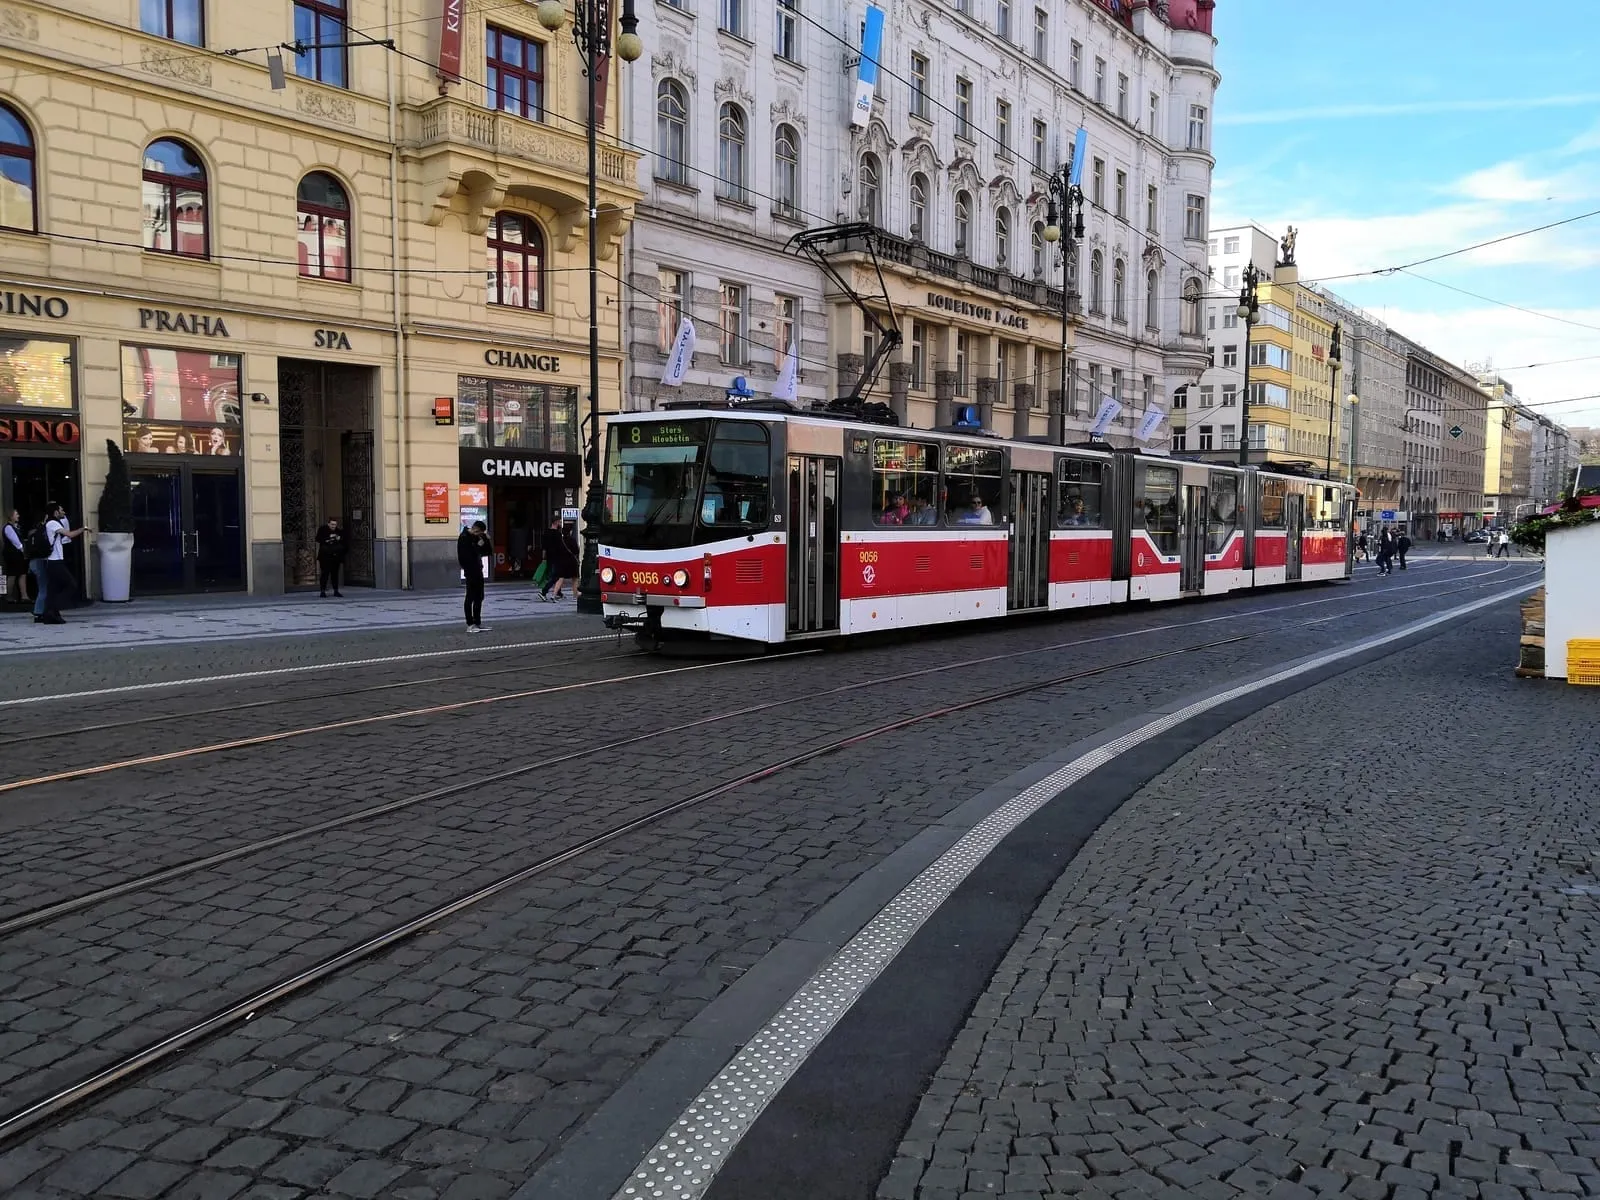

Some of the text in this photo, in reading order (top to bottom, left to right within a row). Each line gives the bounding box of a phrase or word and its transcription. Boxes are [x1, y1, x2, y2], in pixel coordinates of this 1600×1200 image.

[0, 291, 69, 318] INO
[928, 292, 992, 320] KONEKTOR
[139, 308, 229, 337] PRAHA
[314, 329, 352, 350] SPA
[484, 349, 560, 373] CHANGE
[632, 427, 640, 443] 8
[482, 458, 565, 478] CHANGE
[563, 510, 578, 518] ATM
[859, 551, 878, 563] 9056
[632, 571, 659, 585] 9056
